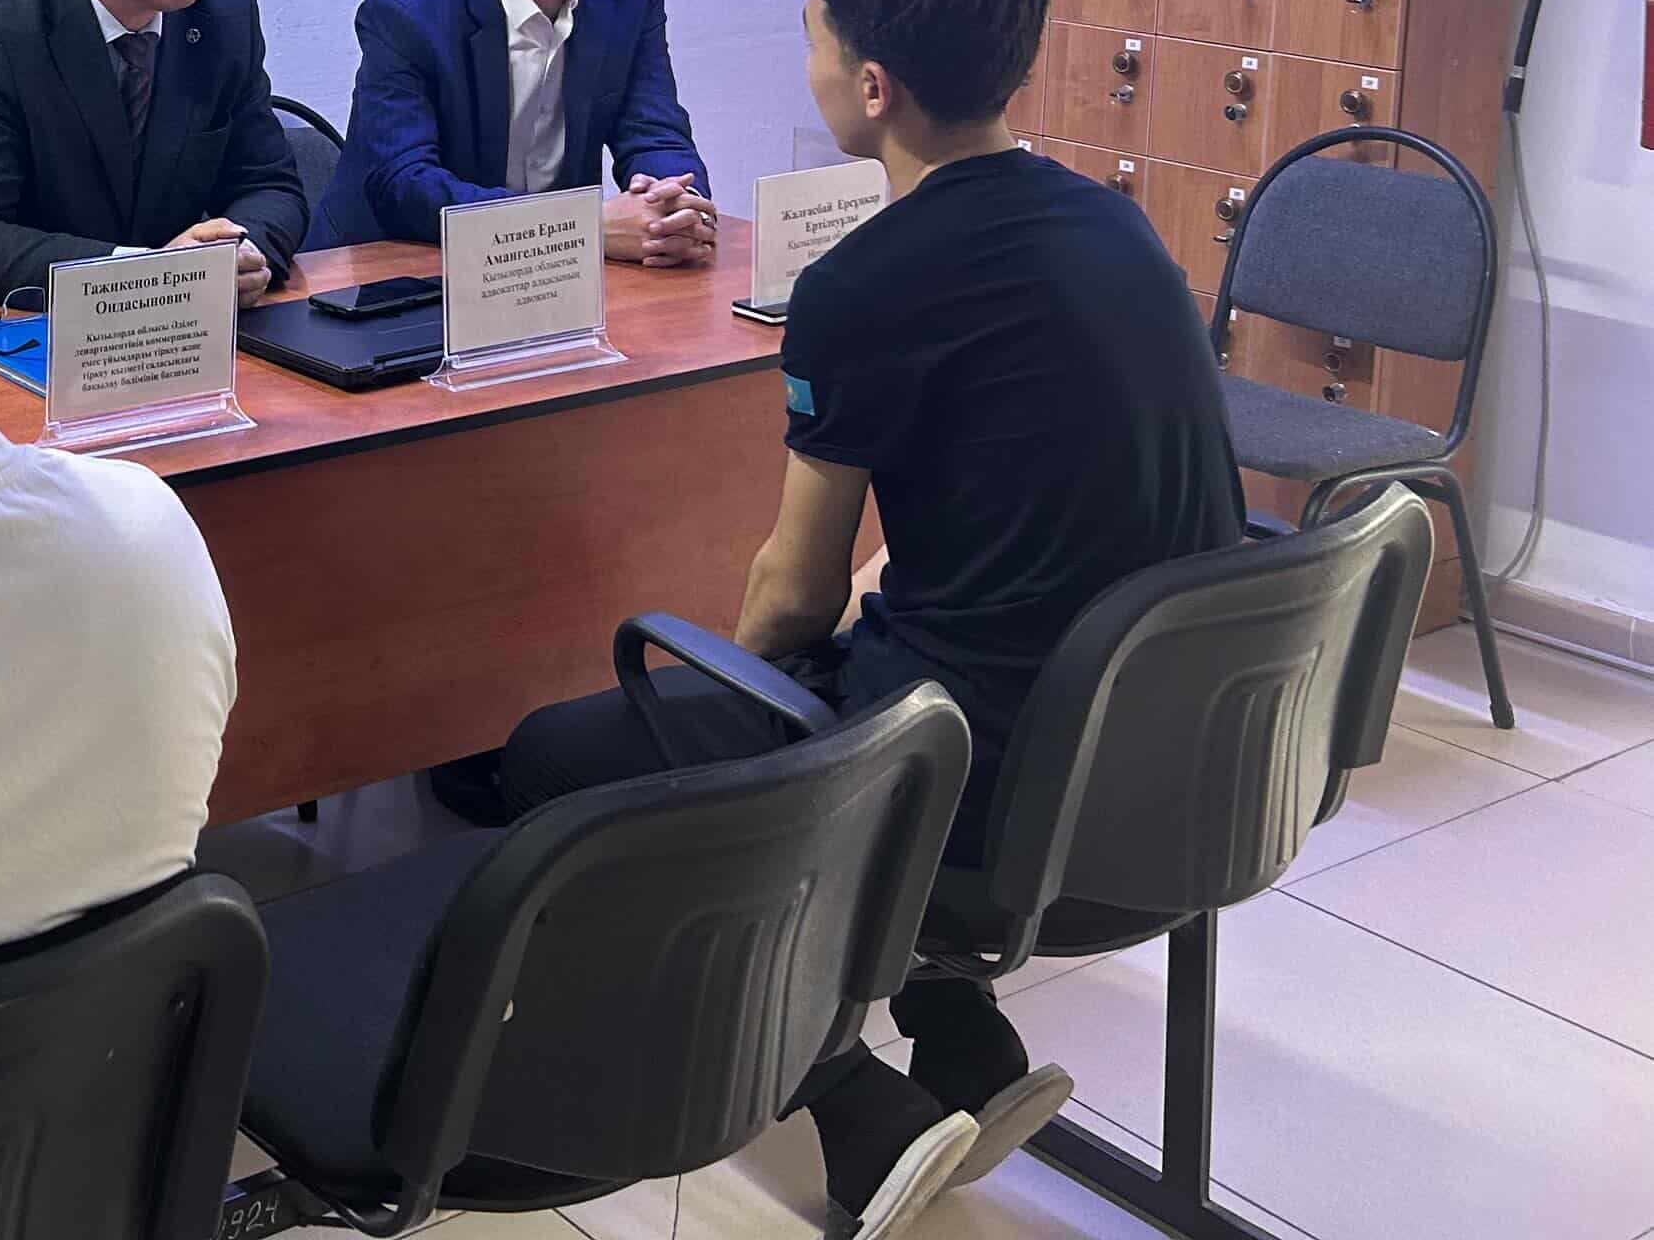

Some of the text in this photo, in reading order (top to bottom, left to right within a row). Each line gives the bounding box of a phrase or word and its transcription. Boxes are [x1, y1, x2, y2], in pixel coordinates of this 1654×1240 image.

[492, 220, 576, 245] Алтаев Ерлан
[162, 270, 207, 288] Еркин
